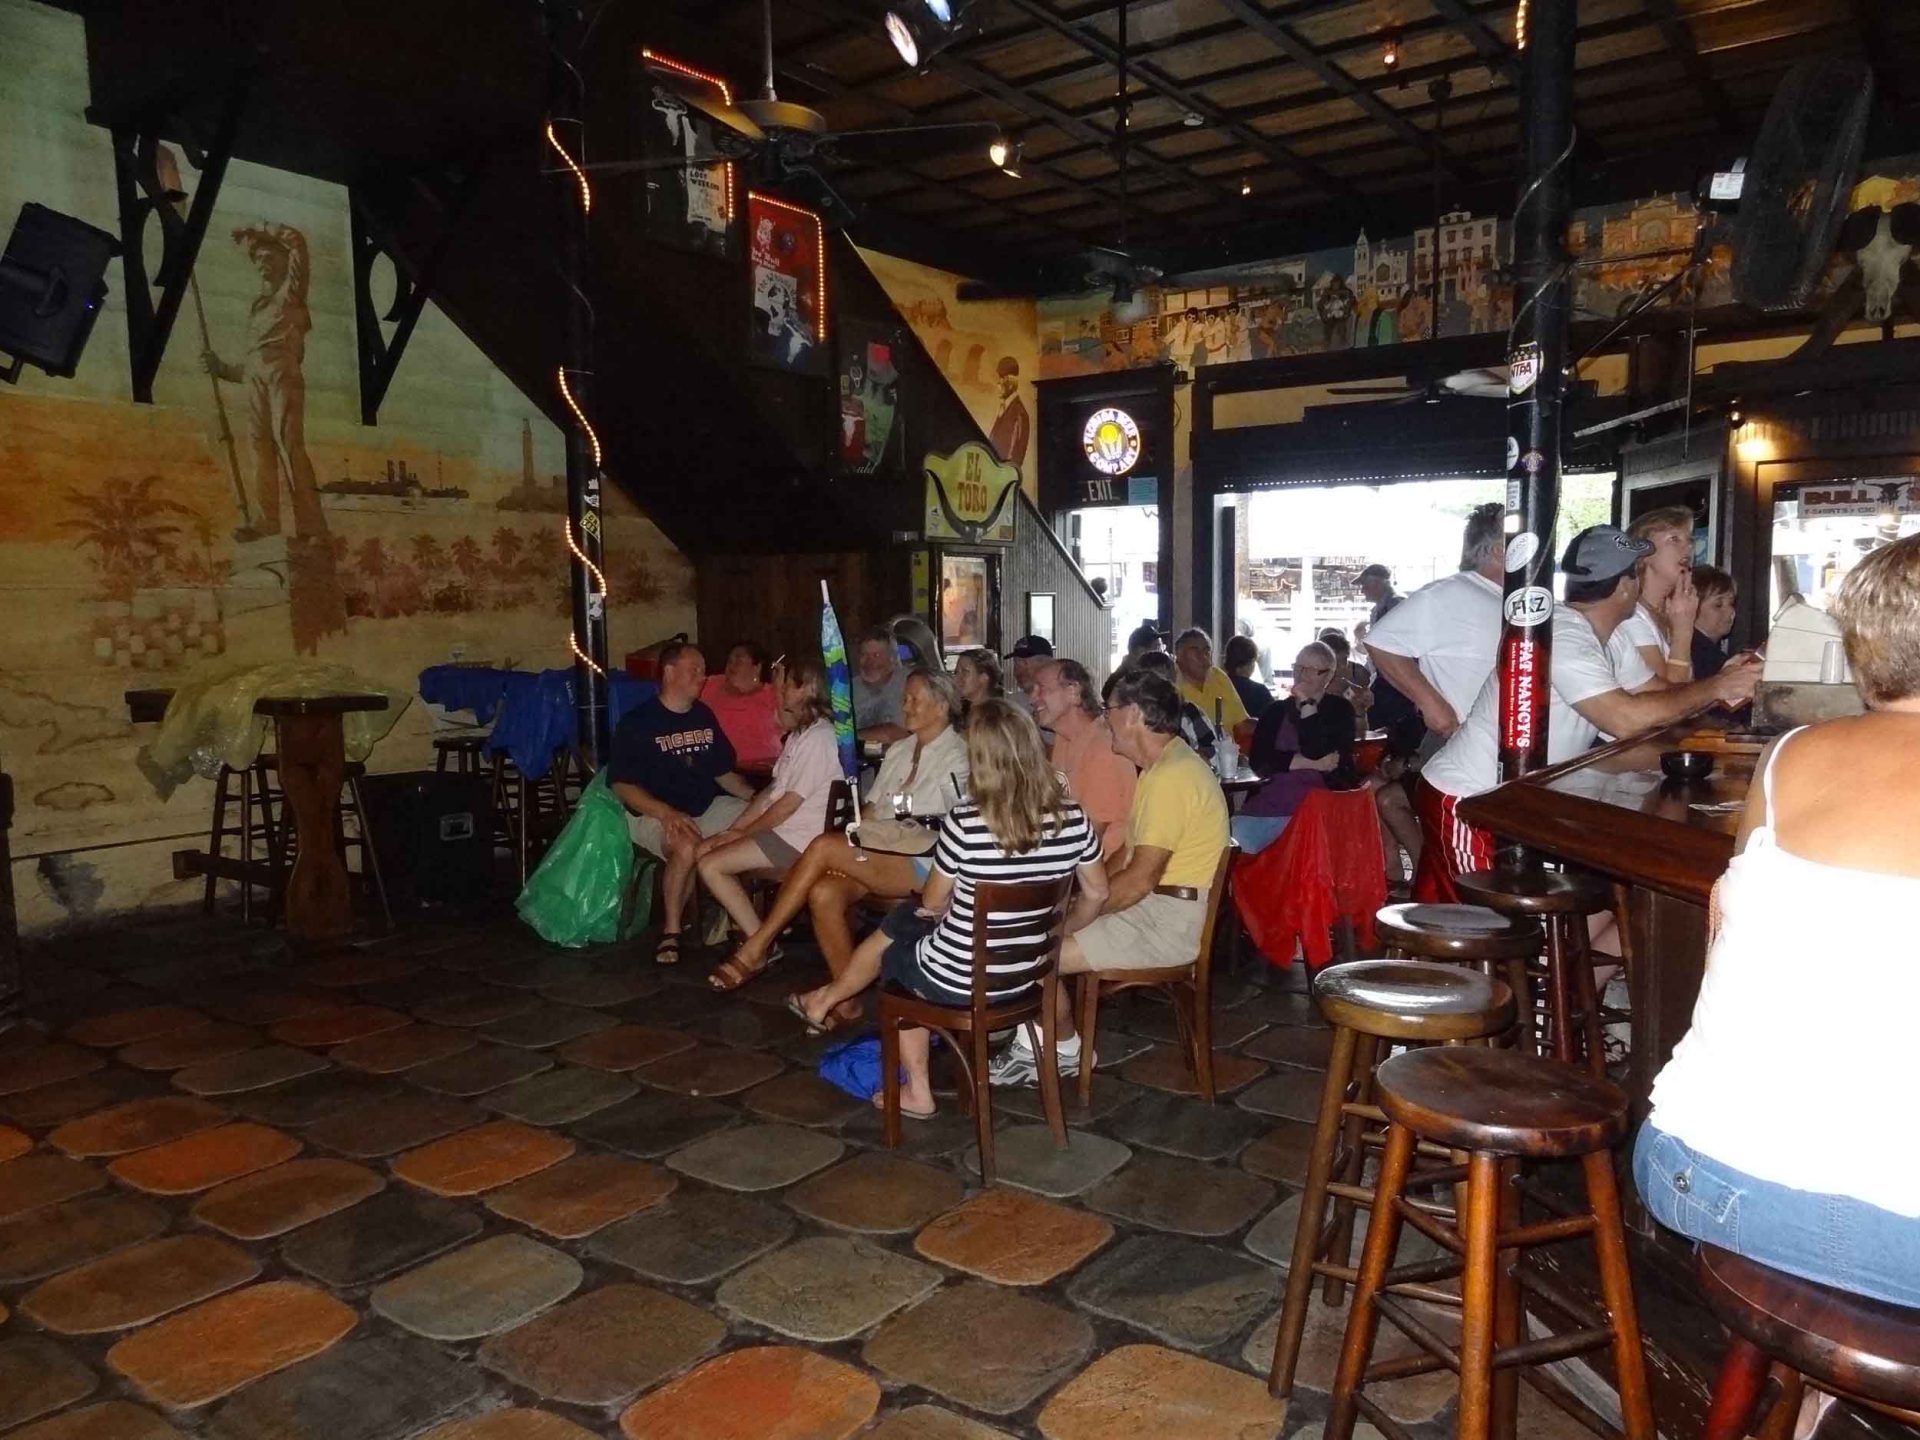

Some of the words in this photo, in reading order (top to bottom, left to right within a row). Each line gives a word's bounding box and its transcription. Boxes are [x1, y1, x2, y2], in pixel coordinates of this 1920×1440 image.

[1084, 410, 1115, 444] FLORIDA
[1118, 411, 1137, 439] BEER
[965, 451, 982, 482] EL
[1089, 447, 1137, 474] COMPANY
[957, 482, 988, 513] TORO
[1087, 479, 1113, 502] EXIT
[1804, 490, 1874, 505] BULL
[1518, 641, 1534, 672] FAT
[1516, 675, 1533, 748] NANCY'S
[655, 728, 714, 752] TIGERS
